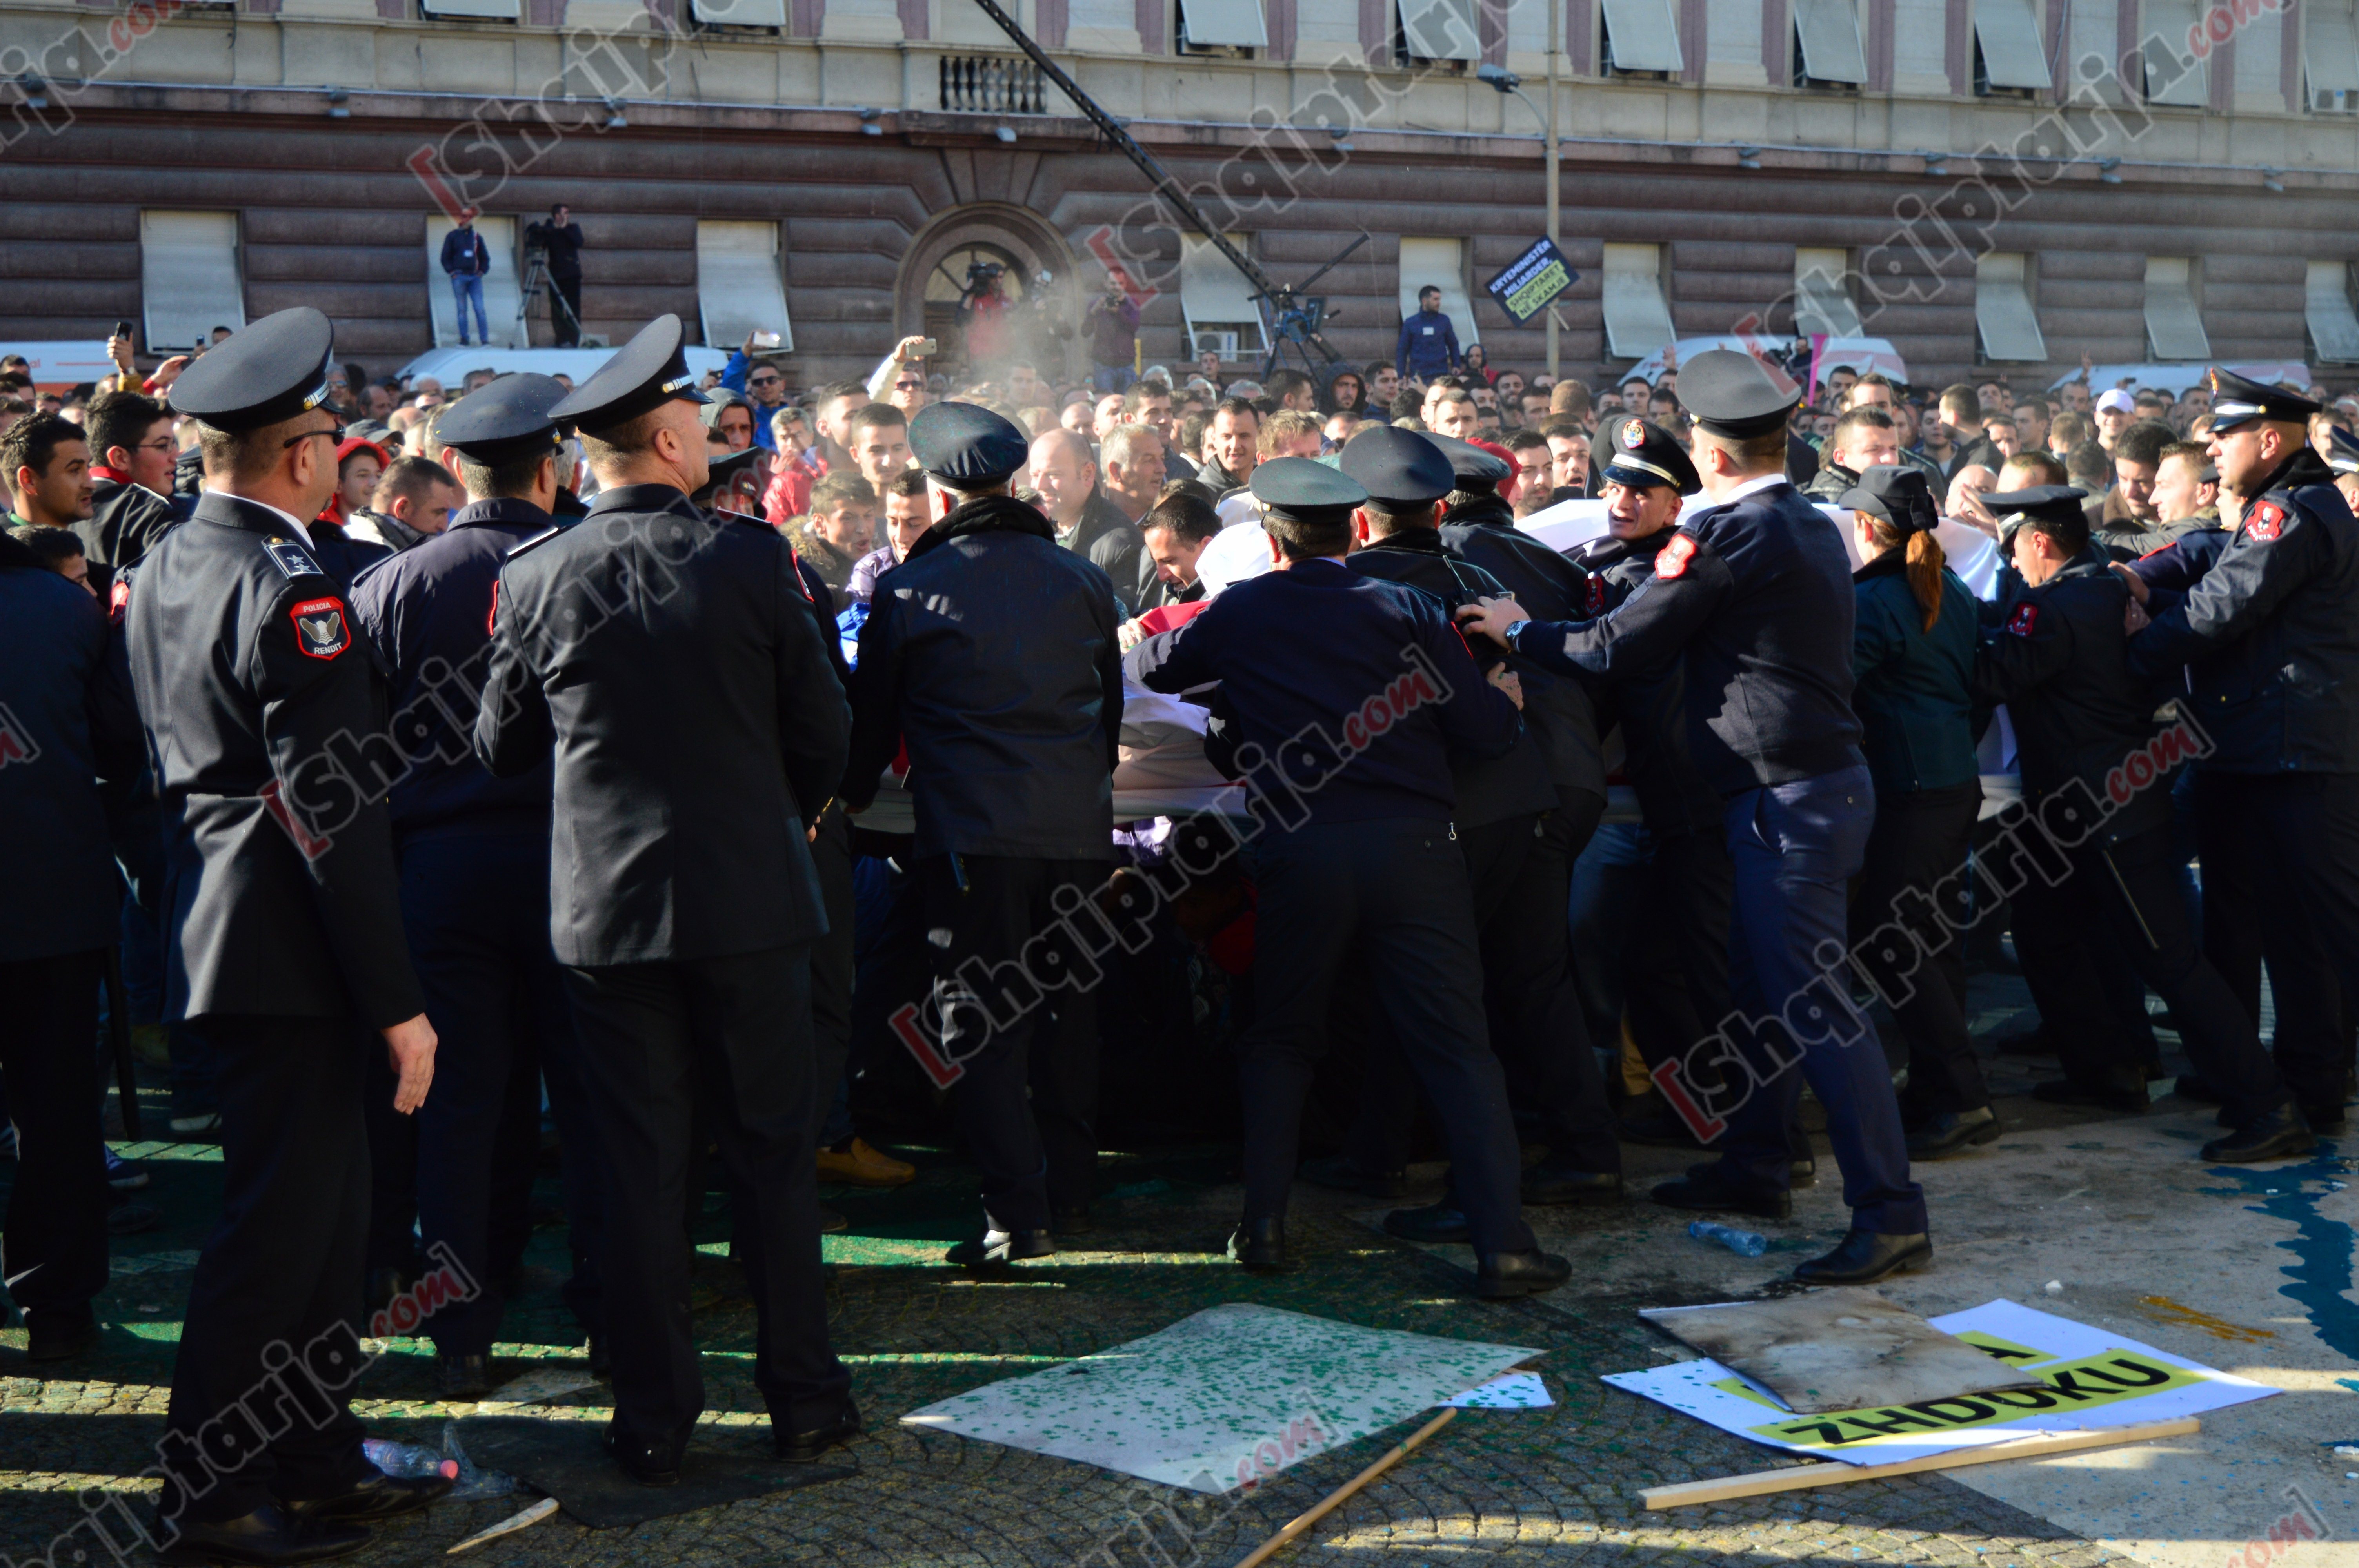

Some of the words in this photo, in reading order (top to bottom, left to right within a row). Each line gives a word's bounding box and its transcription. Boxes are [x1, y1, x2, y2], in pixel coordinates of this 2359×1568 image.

[1532, 276, 1566, 304] SKAMJE
[303, 602, 331, 613] POLICIA
[314, 642, 342, 655] RENDIT
[1781, 1358, 2172, 1445] ZHDUKU
